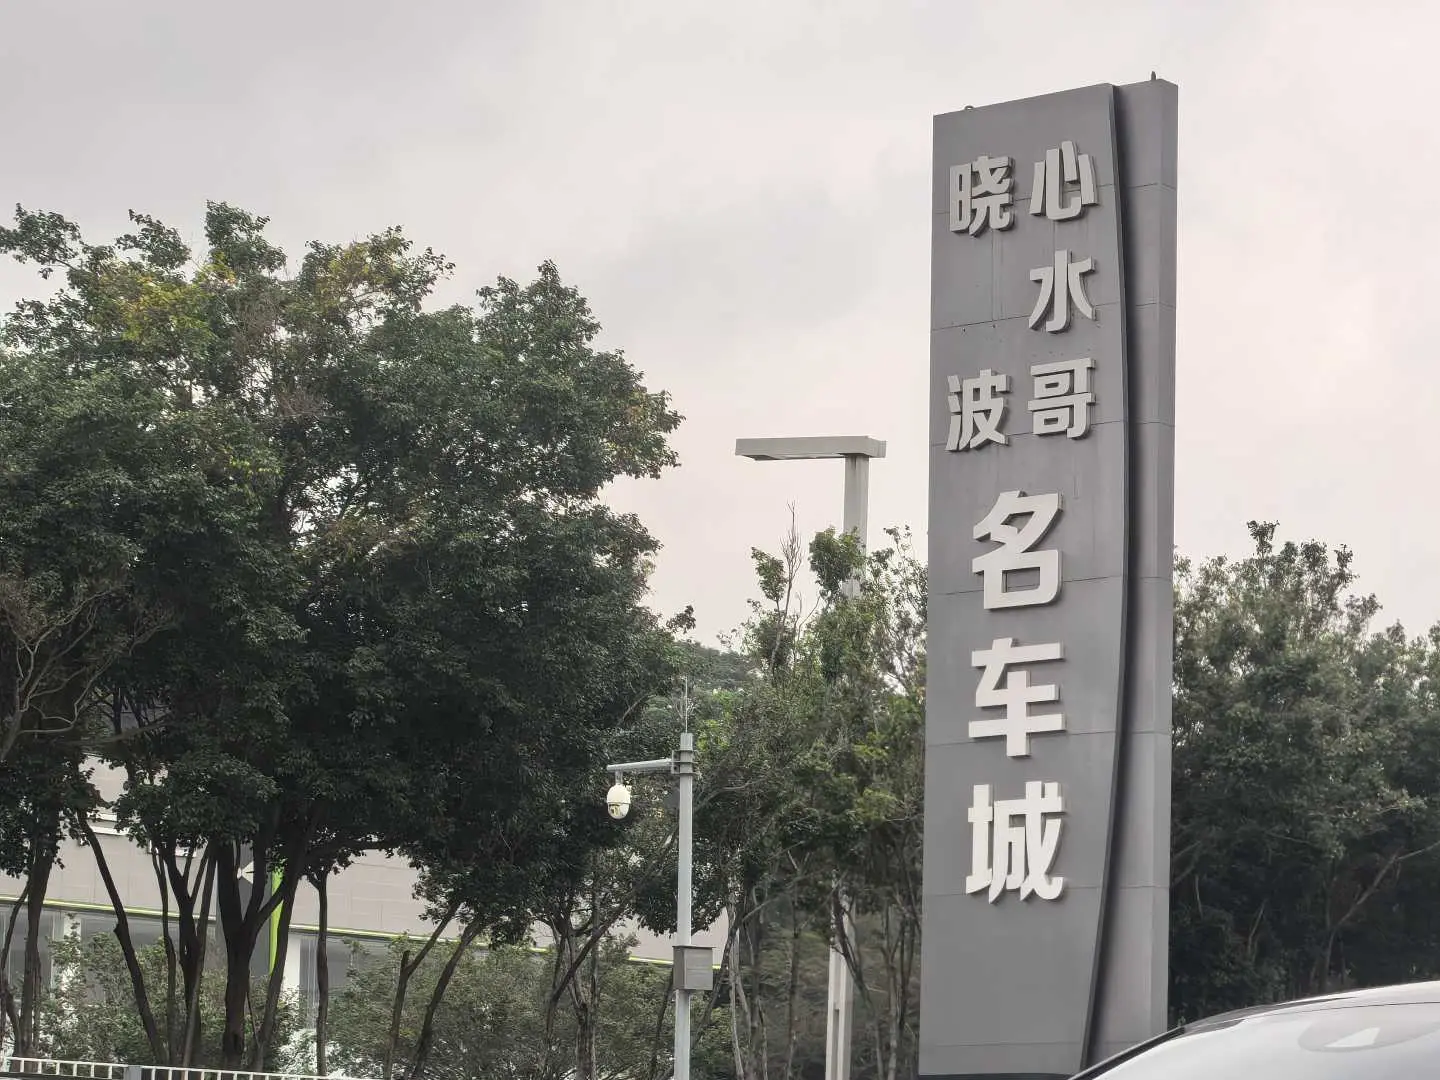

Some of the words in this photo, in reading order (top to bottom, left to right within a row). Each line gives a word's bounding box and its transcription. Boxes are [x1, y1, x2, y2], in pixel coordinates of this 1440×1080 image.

[946, 156, 1015, 451] 晓波
[1029, 141, 1098, 440] 心水哥
[966, 490, 1066, 904] 名车城
